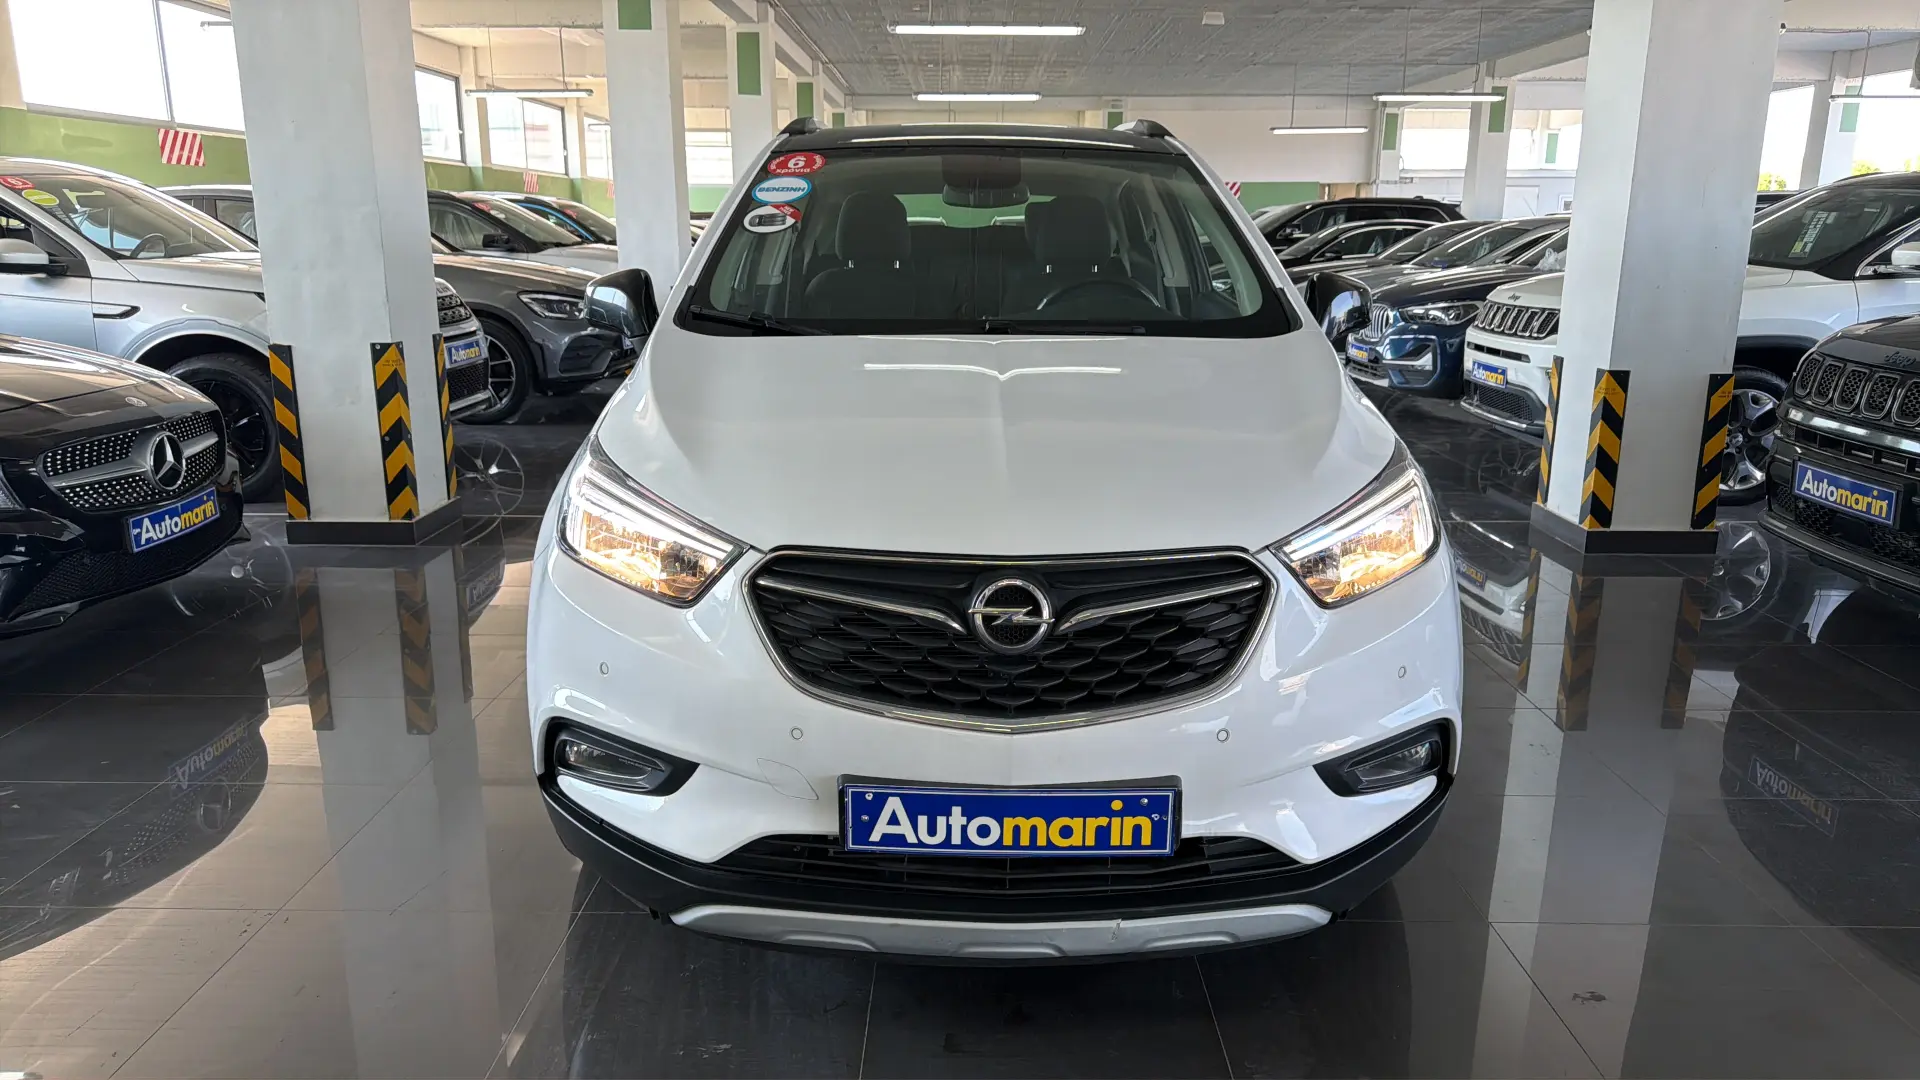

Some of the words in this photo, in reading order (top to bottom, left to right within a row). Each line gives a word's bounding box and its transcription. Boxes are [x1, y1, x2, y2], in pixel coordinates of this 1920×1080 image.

[788, 158, 807, 169] 6
[1883, 350, 1917, 368] Jeep
[1800, 469, 1889, 518] Automarin
[140, 494, 216, 546] Automarin
[868, 796, 1152, 847] Automarin
